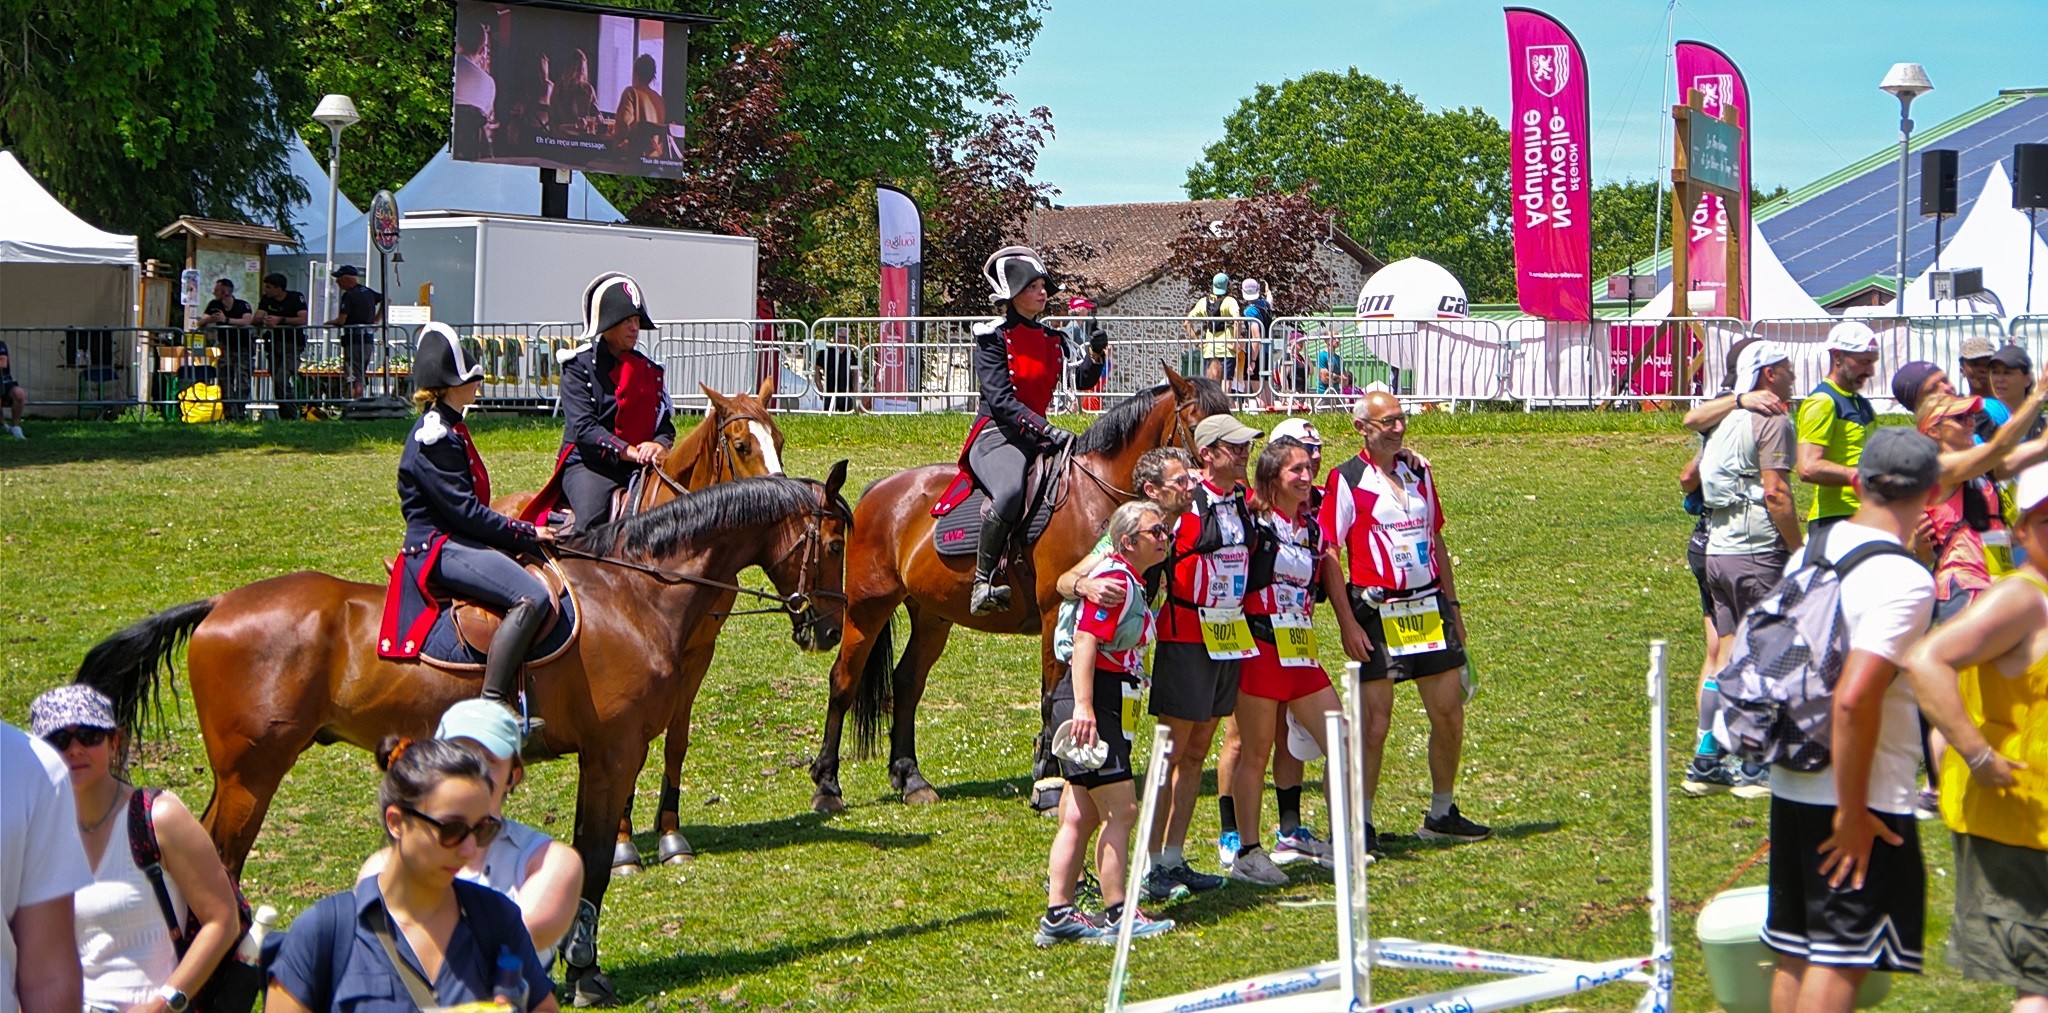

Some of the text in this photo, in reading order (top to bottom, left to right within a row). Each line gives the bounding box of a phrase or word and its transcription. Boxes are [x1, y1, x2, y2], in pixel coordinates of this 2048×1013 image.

[535, 136, 544, 144] Eh
[557, 139, 570, 147] reçu
[1395, 552, 1413, 563] gan
[1211, 582, 1229, 591] gan
[1397, 614, 1424, 633] 9107
[1213, 623, 1237, 641] 9074
[1289, 627, 1309, 645] 8927
